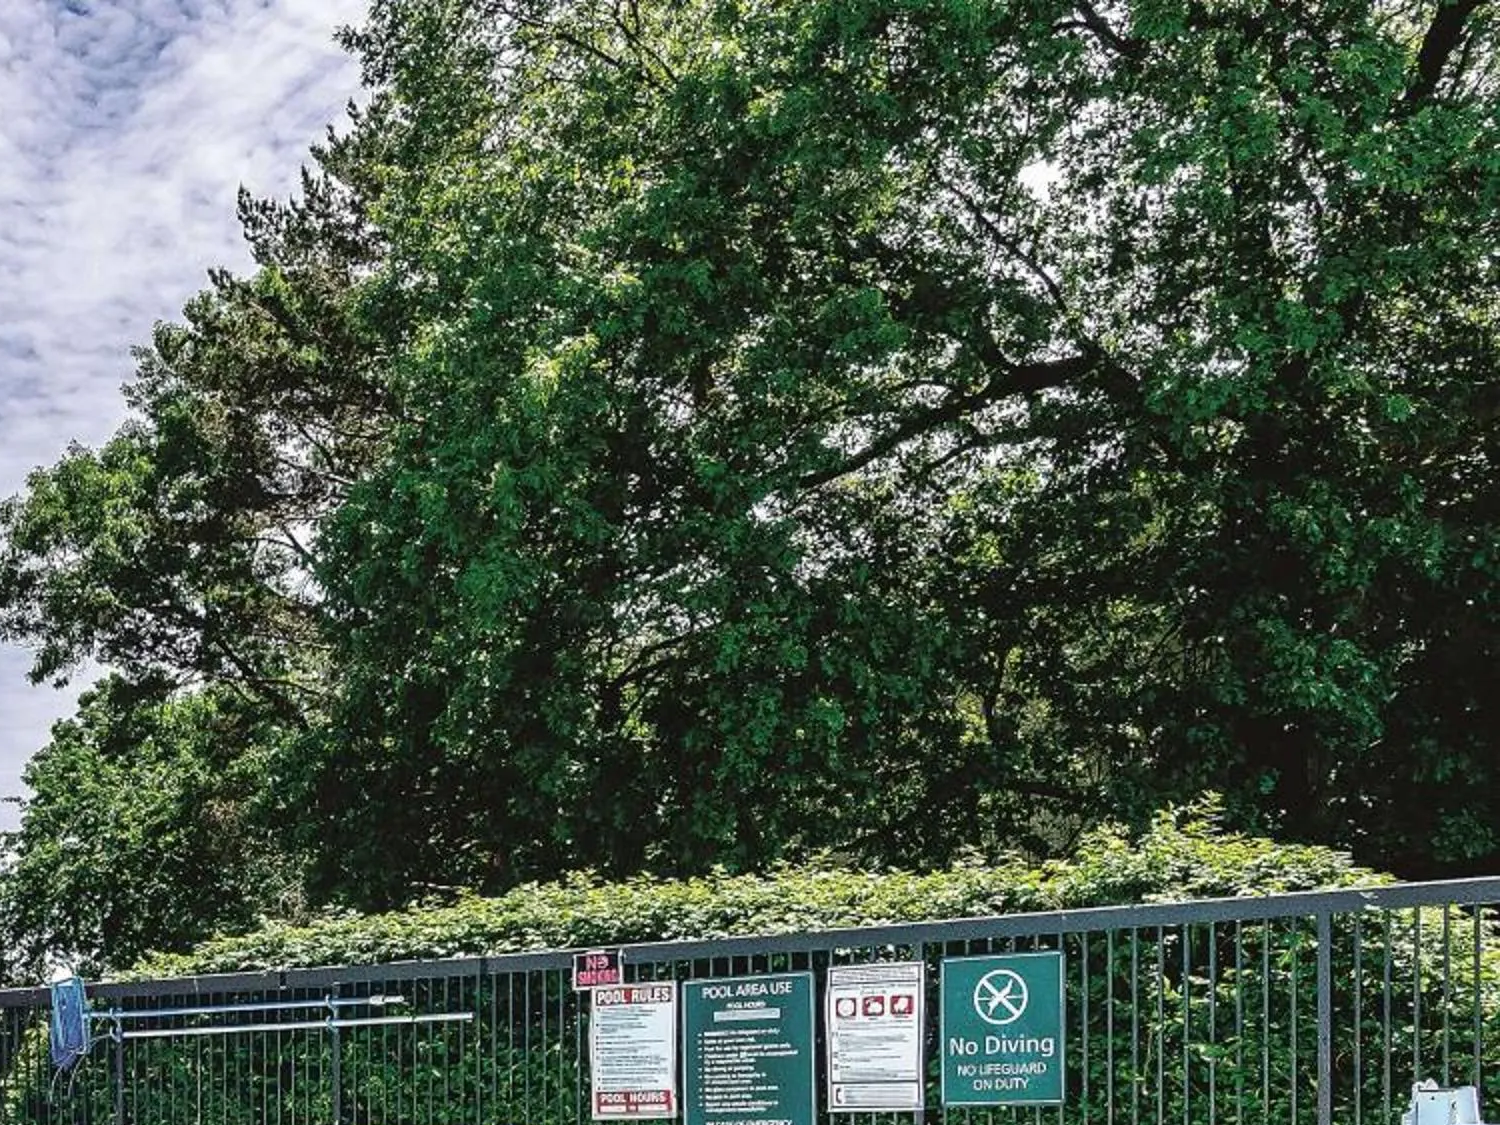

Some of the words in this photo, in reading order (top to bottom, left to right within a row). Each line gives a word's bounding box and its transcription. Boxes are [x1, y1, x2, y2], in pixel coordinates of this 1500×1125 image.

[586, 955, 609, 969] NO
[597, 989, 628, 1004] POOL
[631, 987, 669, 1003] RULES
[702, 985, 734, 999] POOL
[736, 982, 768, 997] AREA
[770, 981, 793, 995] USE
[949, 1037, 979, 1055] No
[985, 1033, 1055, 1057] Diving
[957, 1064, 977, 1076] NO
[980, 1061, 1048, 1075] LIFEGUARD
[973, 1079, 993, 1091] ON
[995, 1076, 1029, 1090] DUTY
[599, 1093, 625, 1104] POOL
[629, 1091, 666, 1104] HOURS
